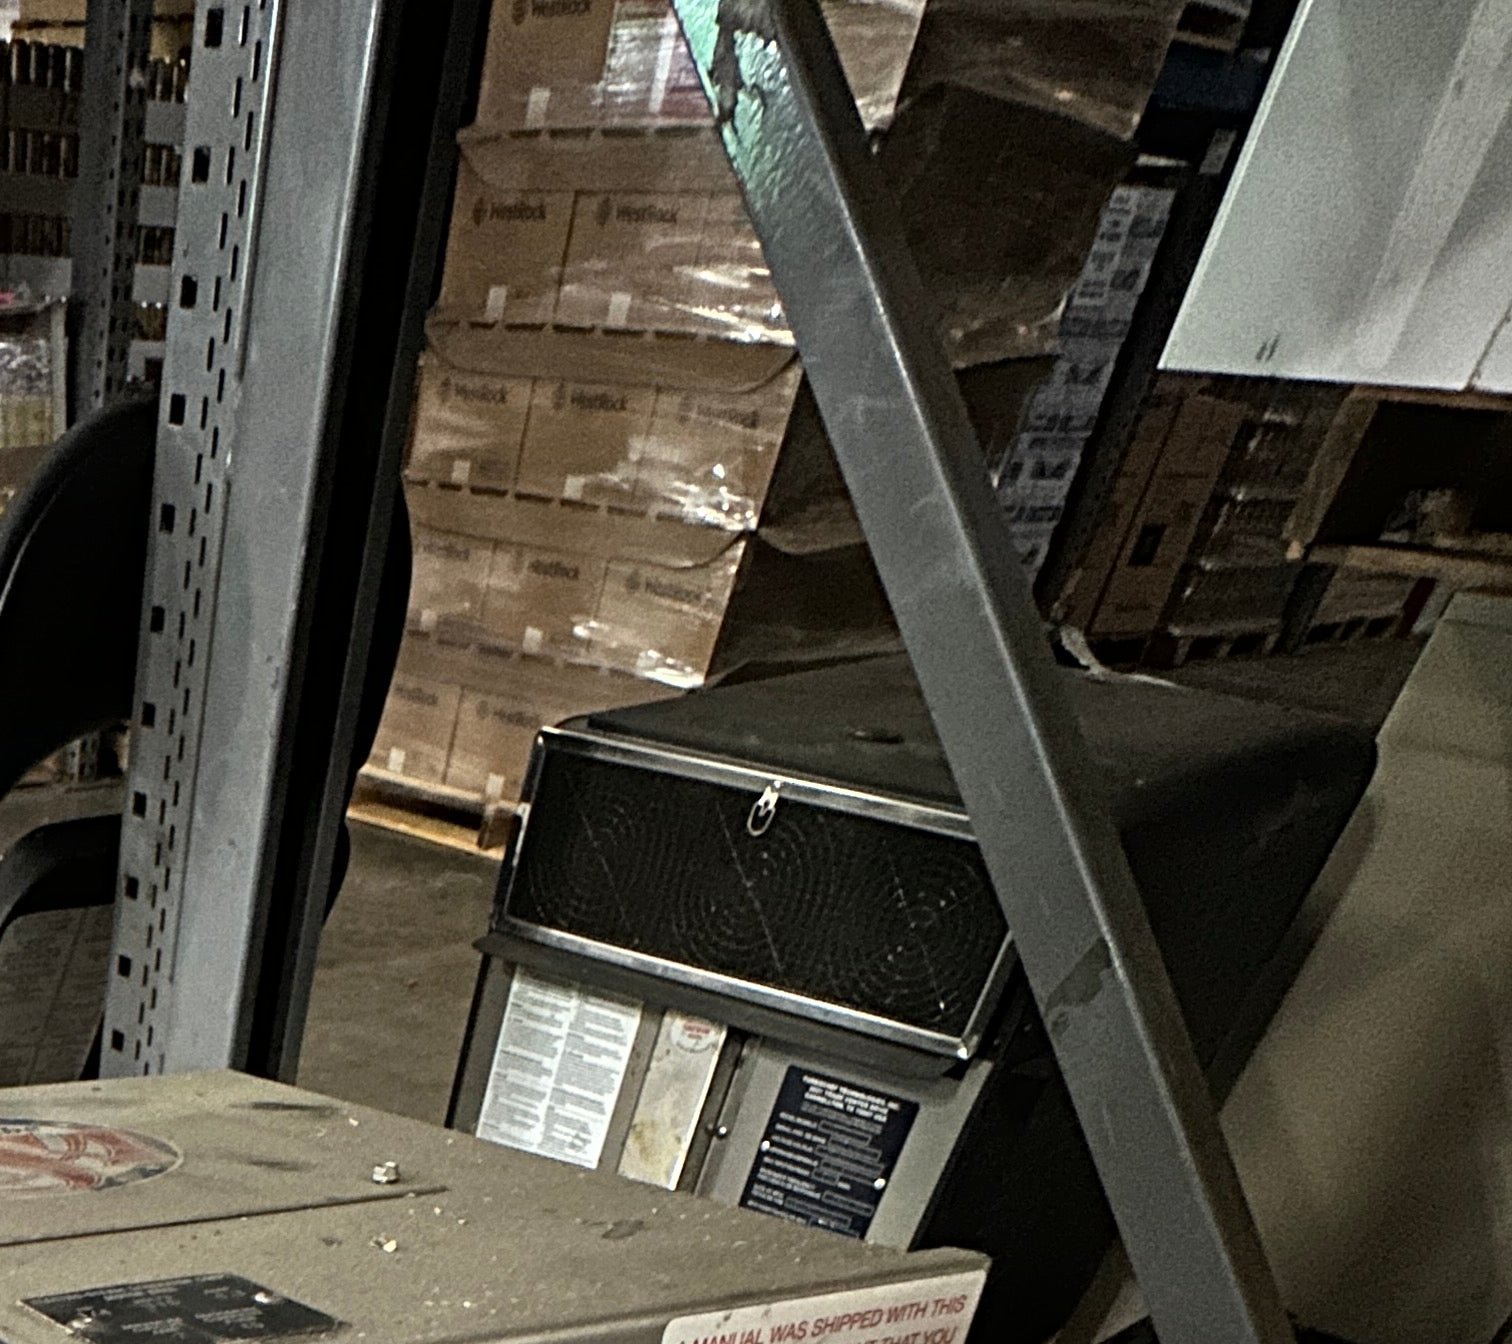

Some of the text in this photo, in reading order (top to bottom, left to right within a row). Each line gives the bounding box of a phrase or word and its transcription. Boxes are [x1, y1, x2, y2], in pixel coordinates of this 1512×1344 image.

[770, 1320, 808, 1344] WAS
[811, 1308, 884, 1338] SHIPPED
[886, 1302, 928, 1324] WITH
[932, 1294, 968, 1316] THIS
